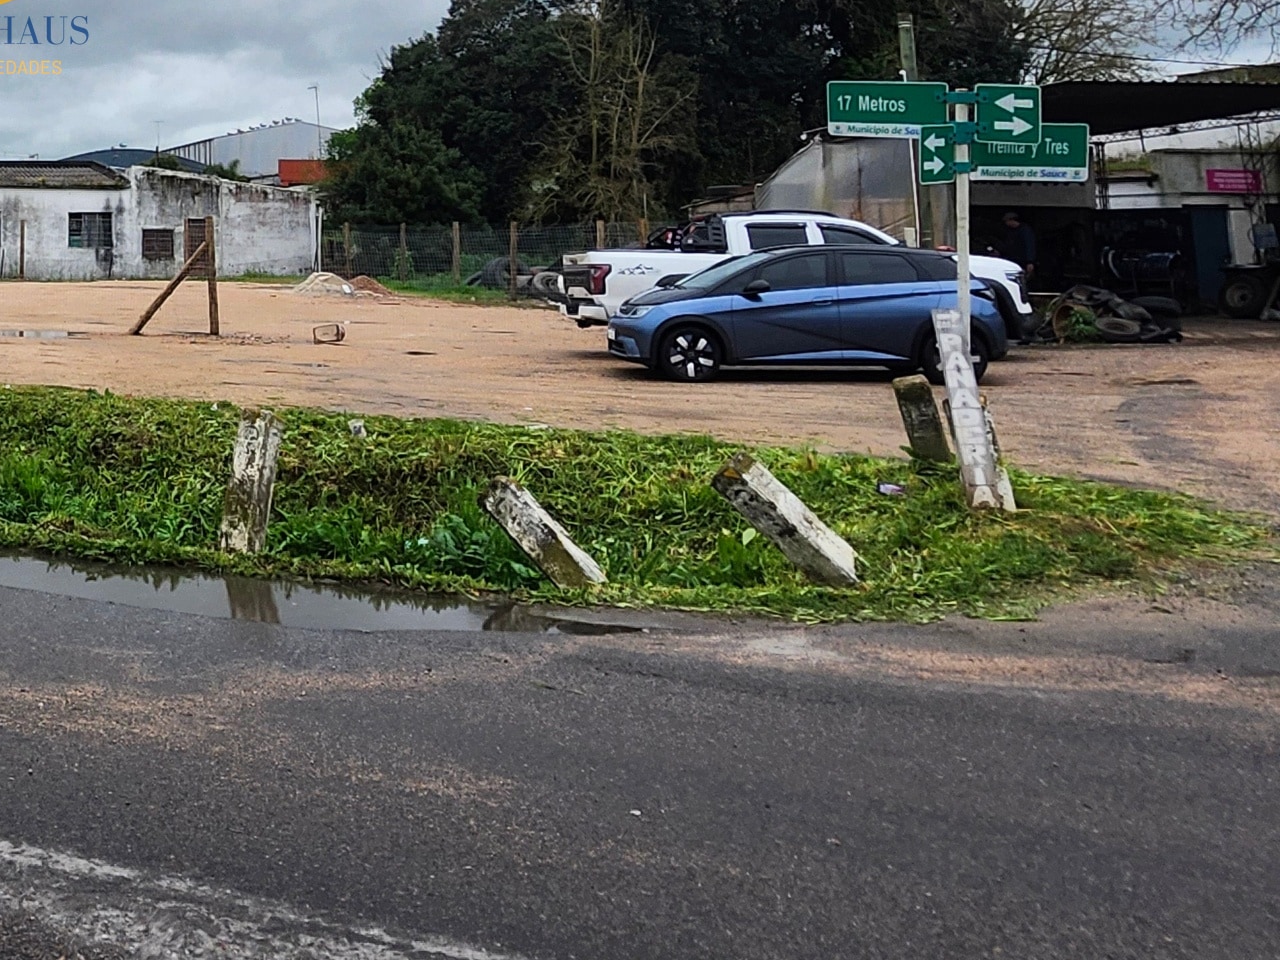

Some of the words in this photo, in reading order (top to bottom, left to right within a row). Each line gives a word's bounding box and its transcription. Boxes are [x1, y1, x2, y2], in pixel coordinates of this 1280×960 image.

[837, 94, 852, 111] 17
[858, 95, 906, 112] Metros
[847, 125, 890, 135] Municipio
[891, 126, 902, 135] de
[903, 127, 920, 136] Sau
[1031, 143, 1039, 158] y
[1044, 138, 1070, 155] Tres
[980, 168, 1025, 178] Municipio
[1026, 168, 1038, 178] de
[1039, 169, 1068, 178] Sauce
